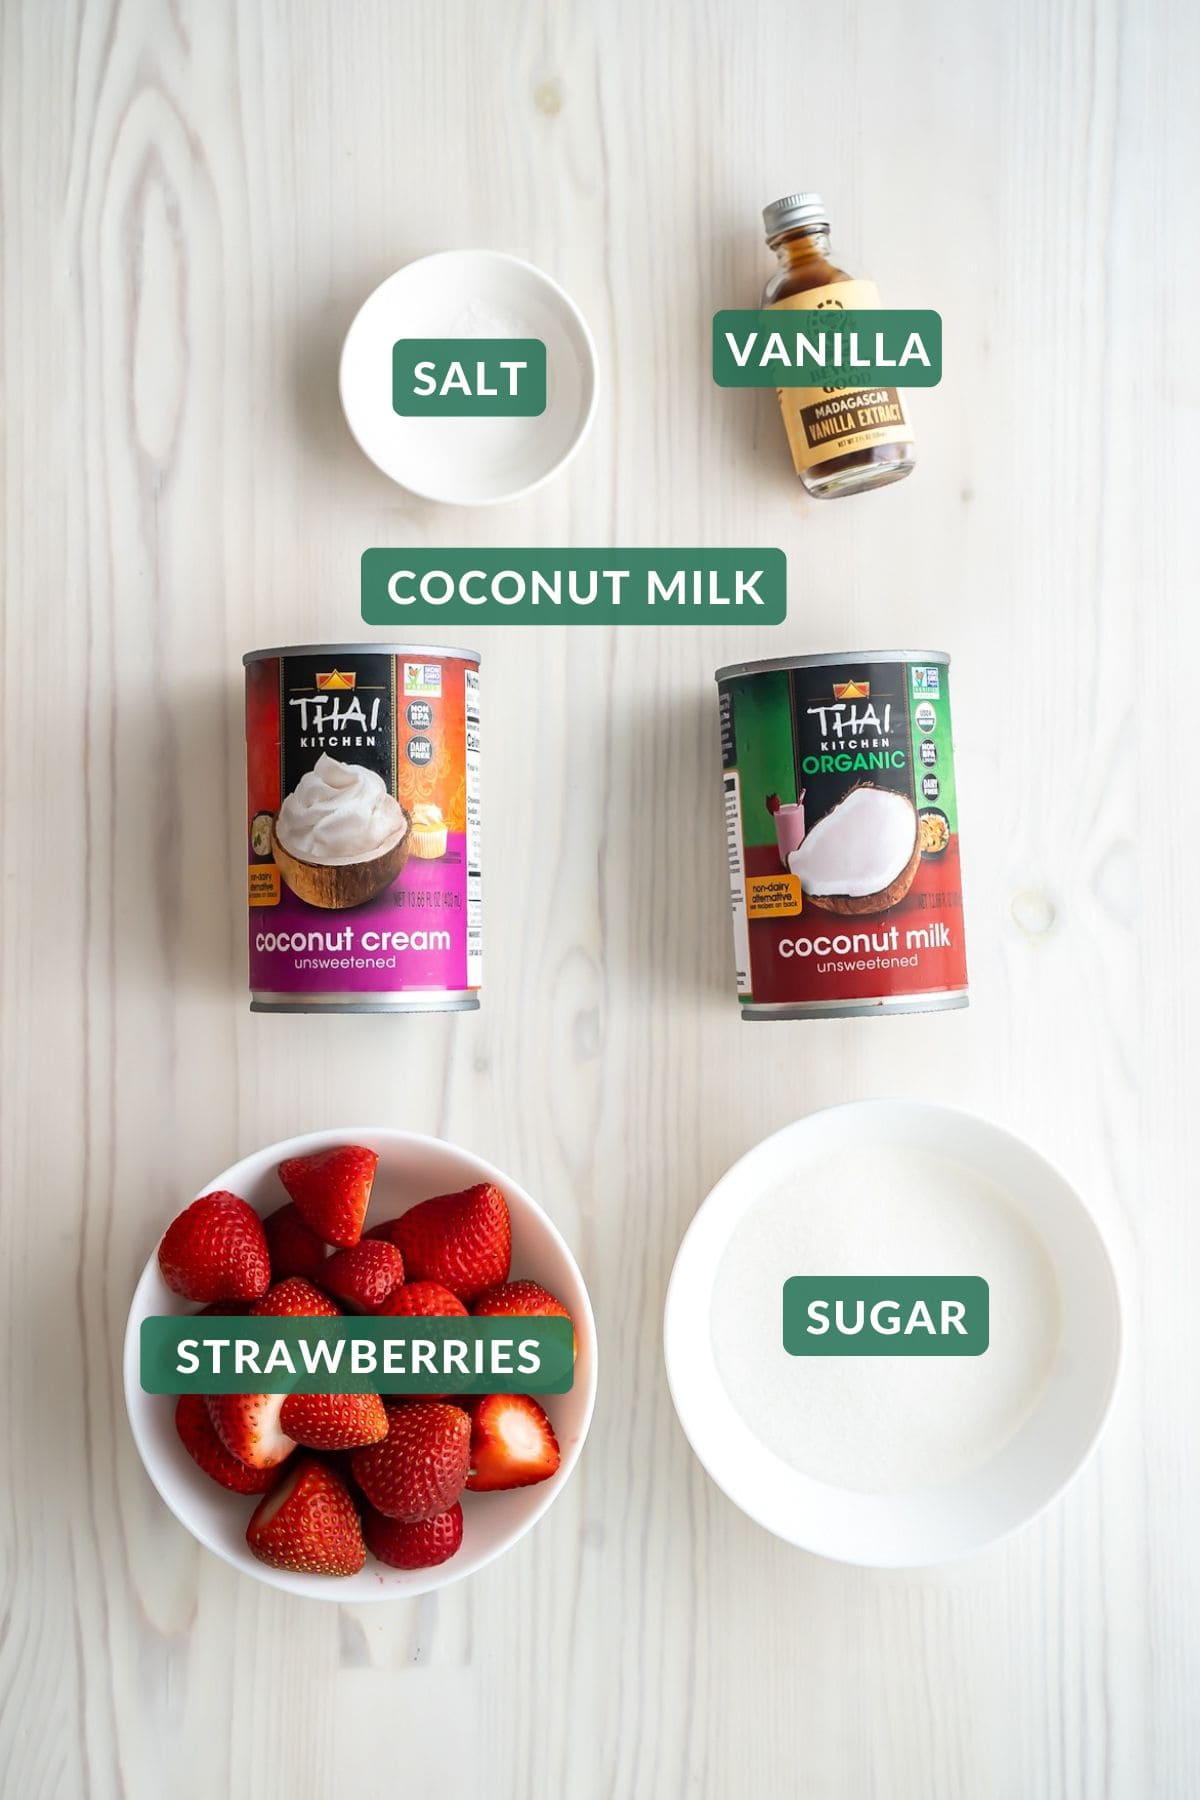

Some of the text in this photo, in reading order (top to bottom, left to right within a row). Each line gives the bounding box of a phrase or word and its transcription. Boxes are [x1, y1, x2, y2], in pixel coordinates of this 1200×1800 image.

[815, 391, 889, 419] MADAGASCAR
[808, 403, 902, 440] VANILLA EXTRACT
[289, 695, 380, 734] THAI
[410, 704, 429, 713] NON
[411, 712, 429, 721] BPA
[807, 703, 891, 738] THAI
[300, 736, 376, 748] KITCHEN
[409, 741, 431, 751] DAIRY
[820, 738, 890, 751] KITCHEN
[802, 750, 905, 775] ORGANIC
[752, 881, 790, 892] non-dairy
[752, 892, 793, 903] alternative
[256, 926, 451, 952] coconut cream
[778, 922, 951, 959] coconut milk
[294, 955, 396, 969] unsweetened
[816, 953, 919, 974] unsweetened
